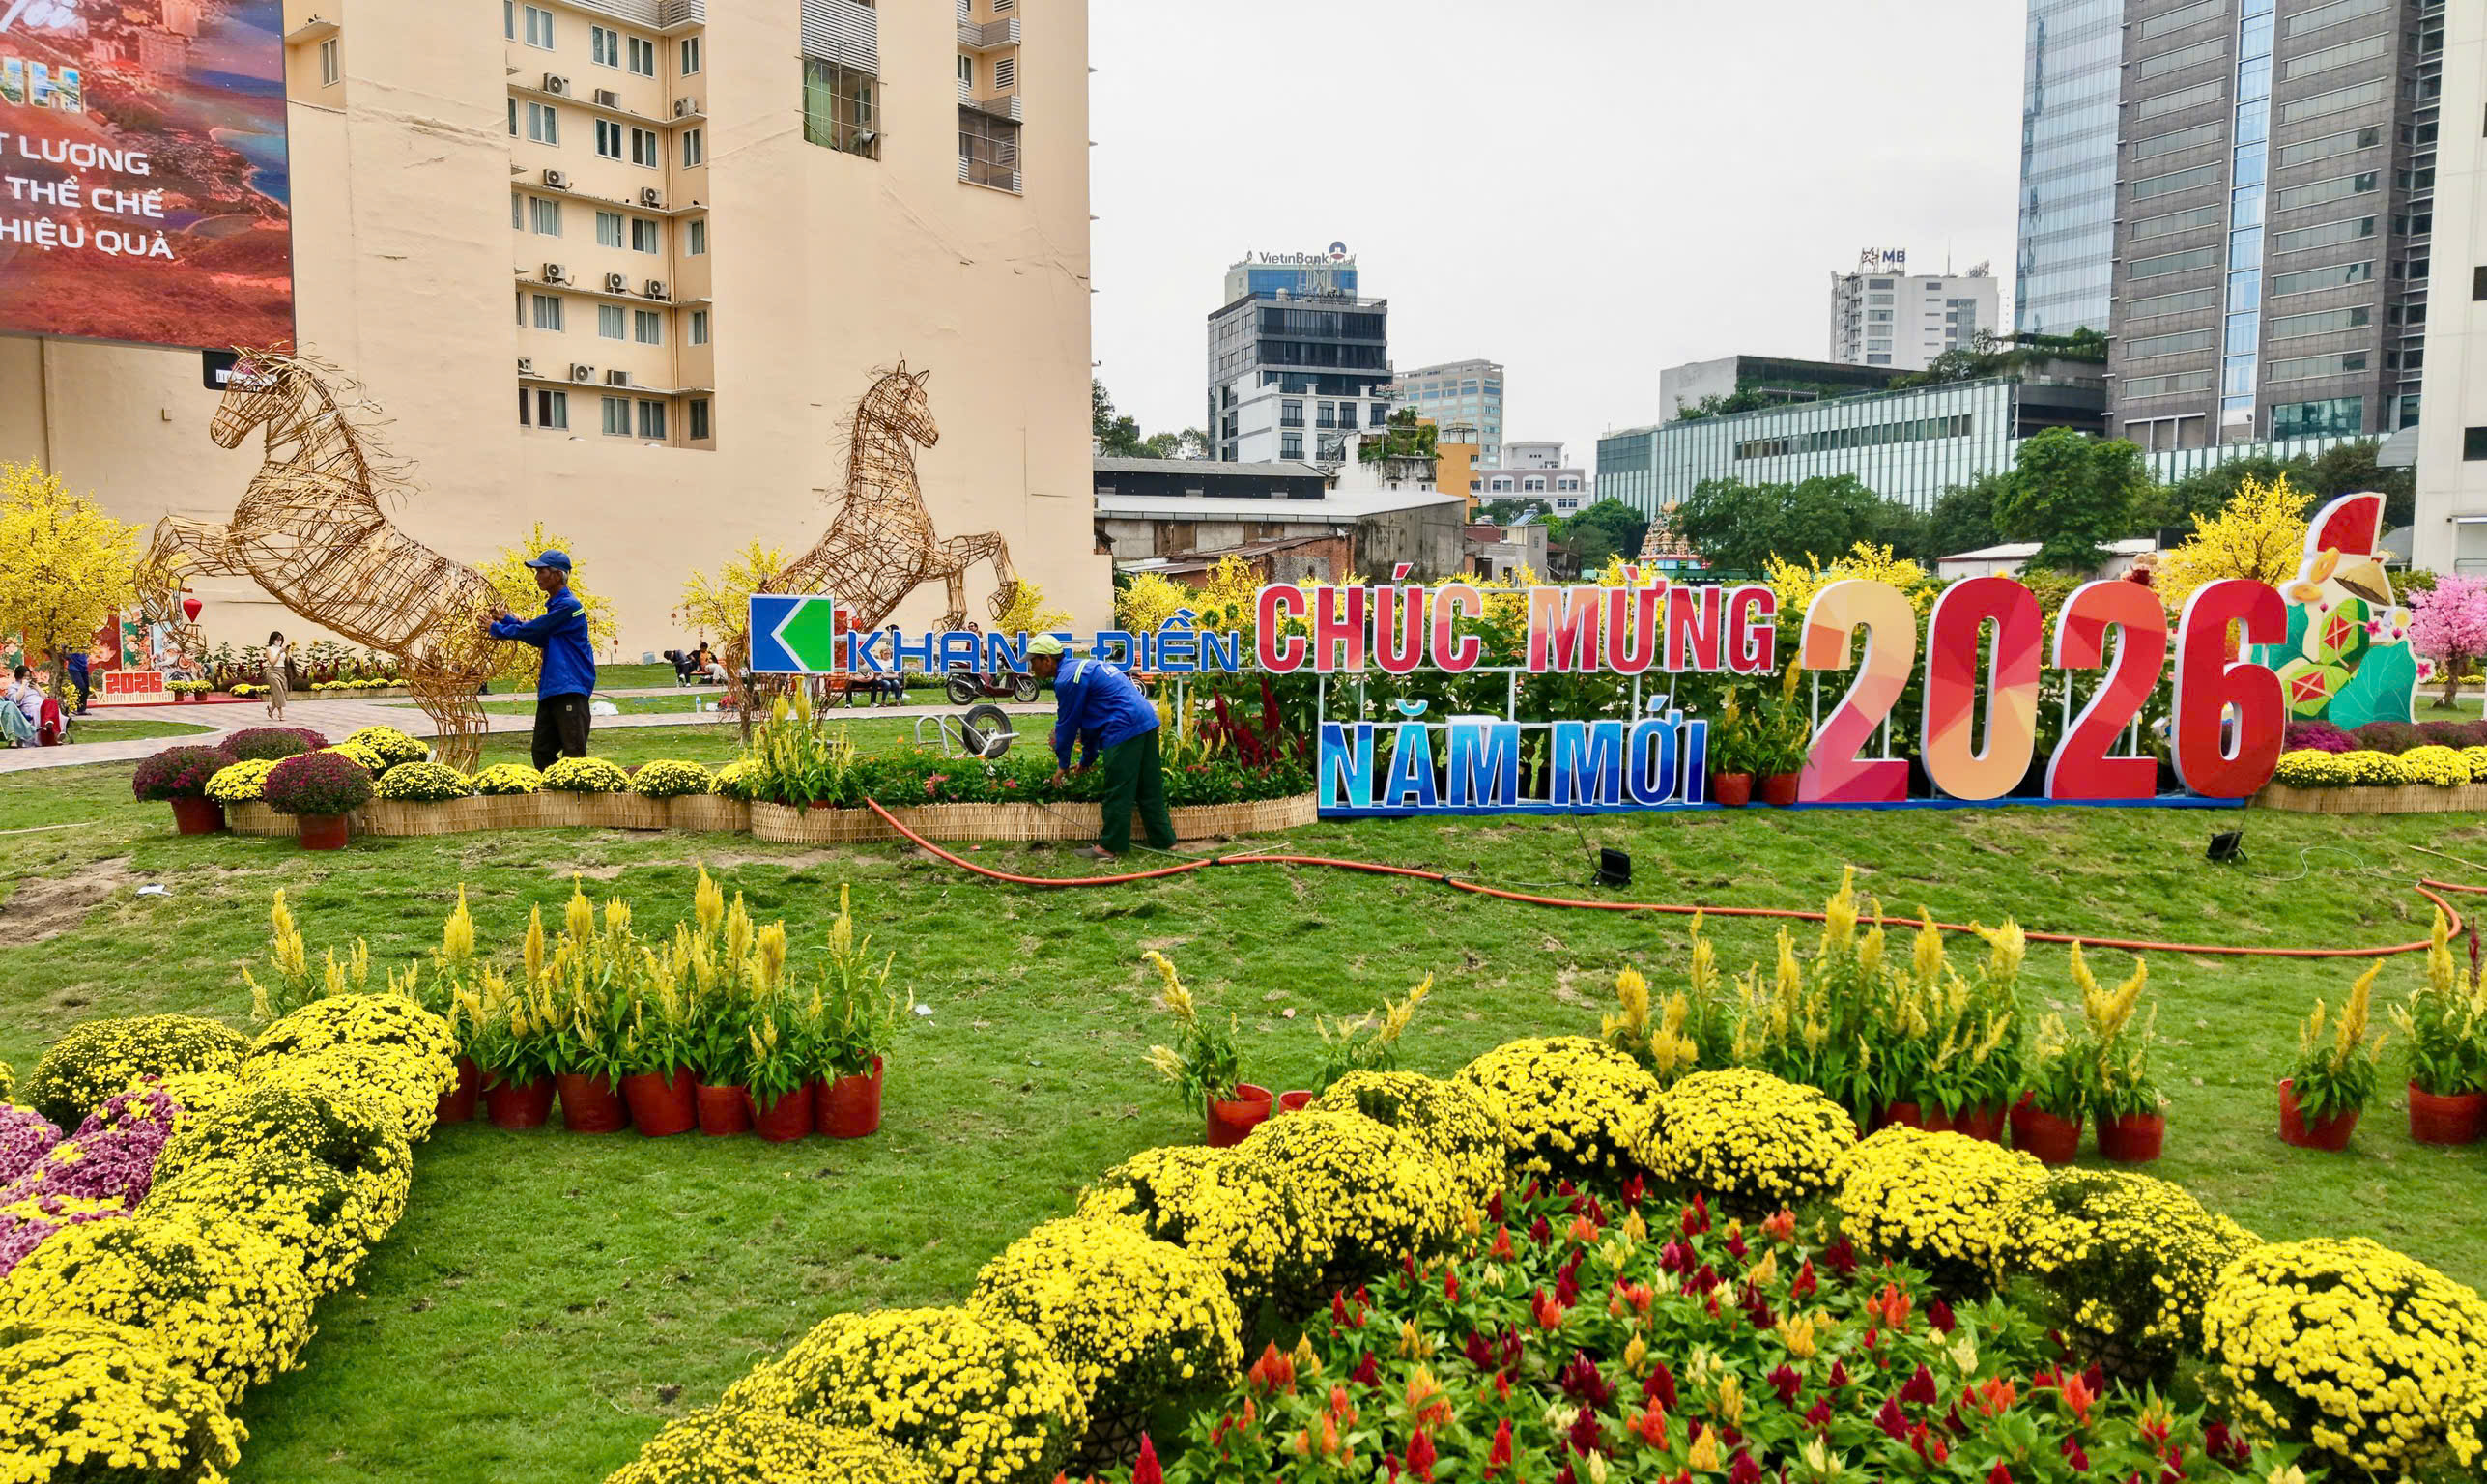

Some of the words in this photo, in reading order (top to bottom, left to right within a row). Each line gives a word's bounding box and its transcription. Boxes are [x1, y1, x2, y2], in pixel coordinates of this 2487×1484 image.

[19, 135, 150, 176] LƯỢNG
[5, 175, 82, 209] THỂ
[91, 187, 164, 218] CHẾ
[0, 216, 85, 251] HIỆU
[95, 230, 175, 260] QUẢ
[1259, 252, 1329, 264] VietinBank
[1882, 250, 1905, 263] MB
[1257, 562, 1483, 674] CHÚC
[1528, 564, 1777, 675] MỪNG
[846, 630, 1072, 674] KHAN
[1090, 607, 1241, 673] ĐIỀN
[105, 672, 163, 694] 2026
[1796, 576, 2288, 801] 2026
[1318, 699, 1522, 808] NĂM
[1550, 694, 1708, 807] MỚI
